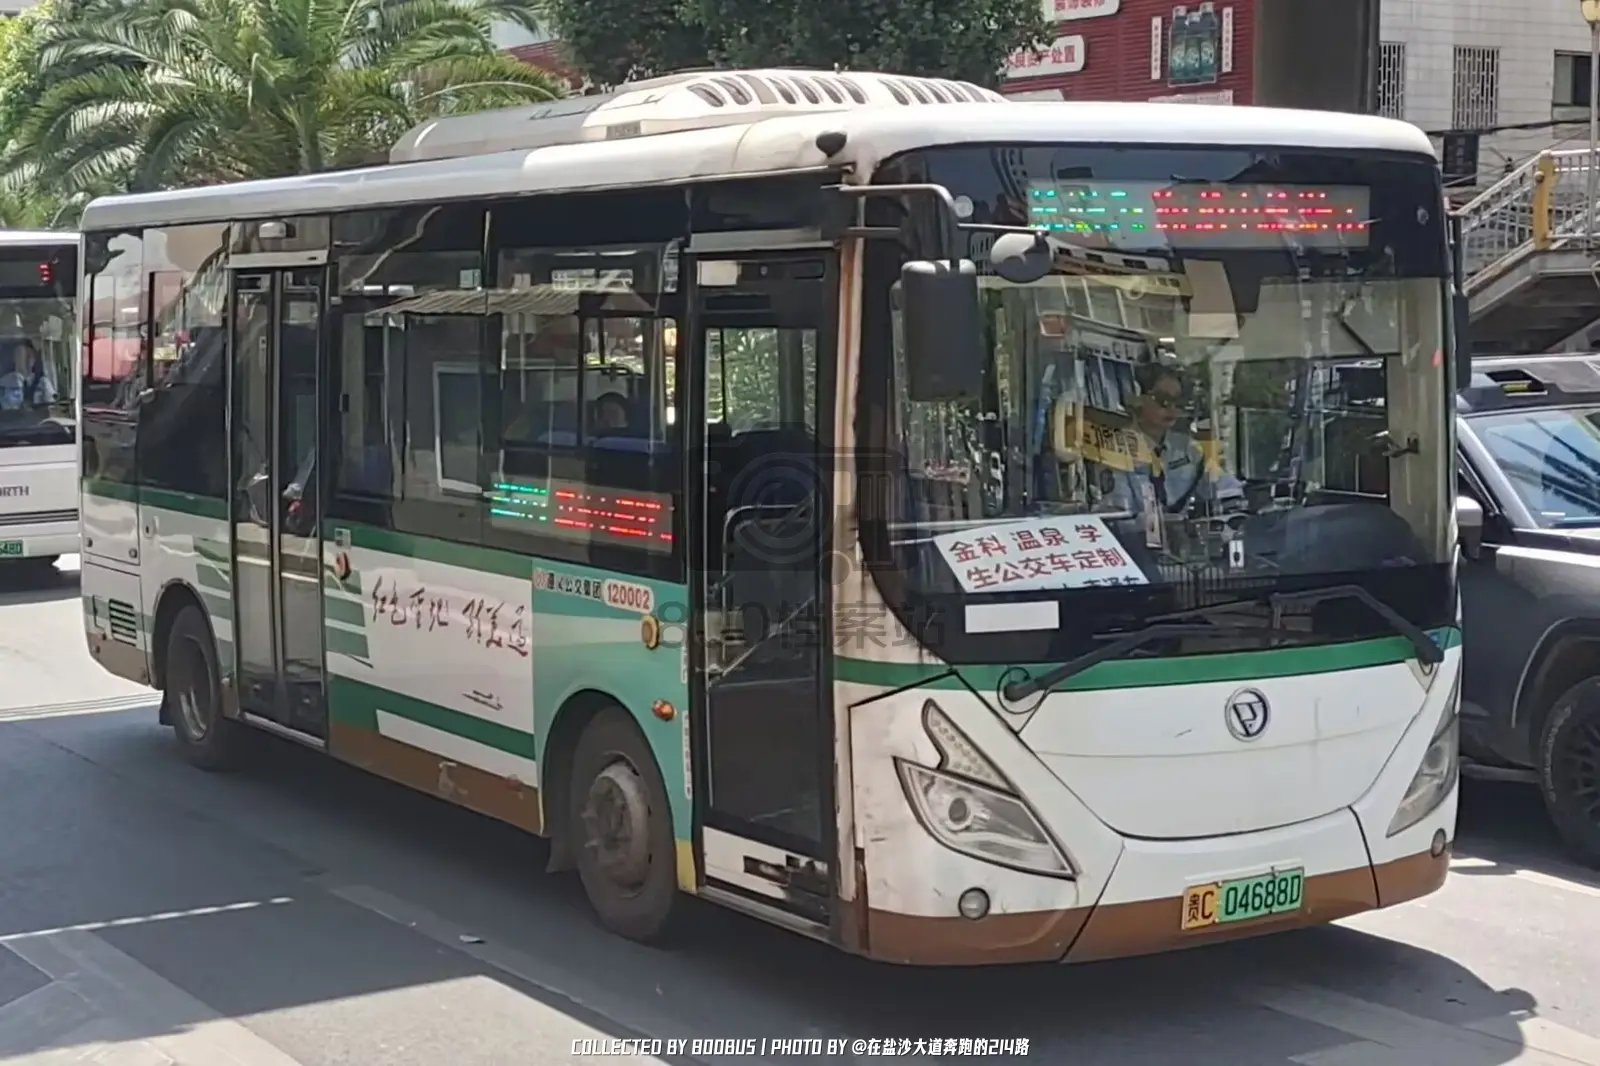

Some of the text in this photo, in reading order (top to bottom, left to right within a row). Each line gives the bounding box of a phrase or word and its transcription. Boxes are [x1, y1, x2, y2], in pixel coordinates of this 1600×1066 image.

[949, 523, 1103, 563] 金科 温泉 学
[966, 547, 1127, 589] 生公交车定制
[607, 583, 650, 611] 120002
